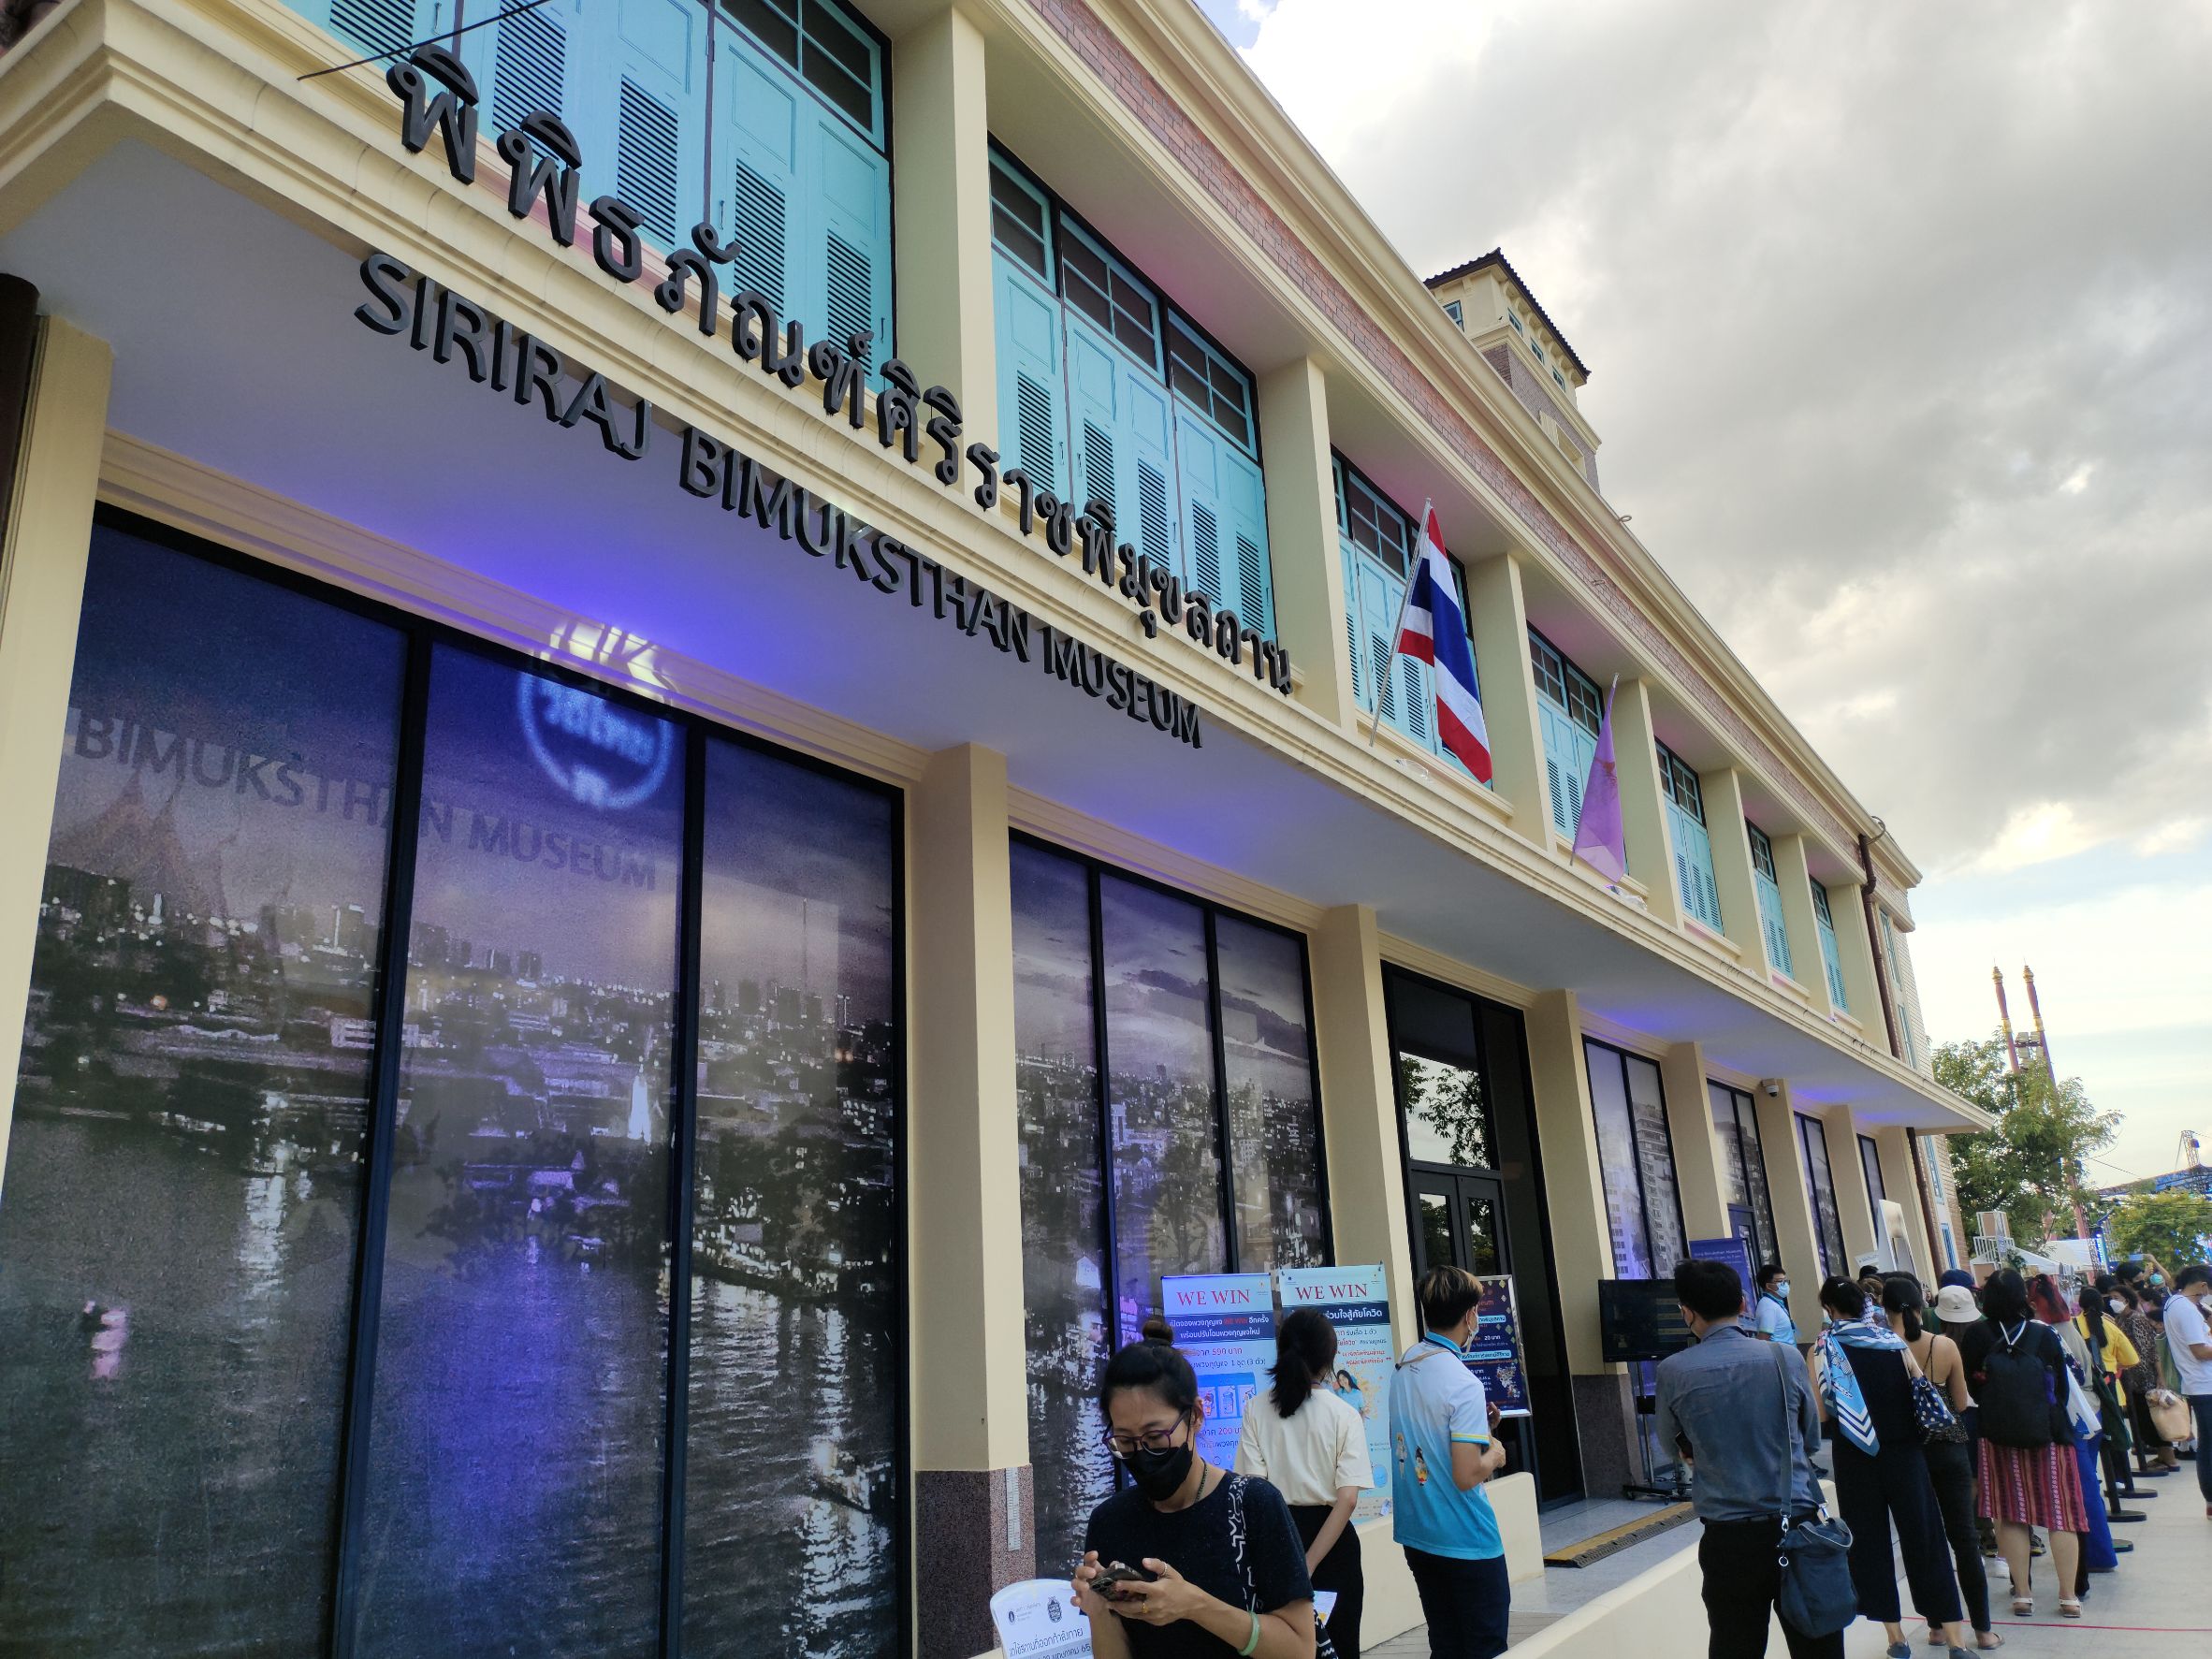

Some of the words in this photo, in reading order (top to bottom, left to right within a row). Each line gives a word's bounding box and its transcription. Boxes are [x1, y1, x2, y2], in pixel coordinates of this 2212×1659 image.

[386, 44, 1293, 694] พิพิธภัณฑ์ศิริราชพิมุขสถาน
[354, 255, 653, 461] SIRIRAJ
[679, 428, 1031, 662] BIMUKSTHAN
[1043, 625, 1203, 749] MUSEUM
[468, 809, 657, 891] MUSEUM
[1176, 1291, 1207, 1305] WE
[1211, 1289, 1250, 1303] WIN
[1295, 1287, 1324, 1300] WE
[1329, 1284, 1368, 1297] WIN
[1324, 1307, 1383, 1321] ร่วมใจสู้ภัยโควิด
